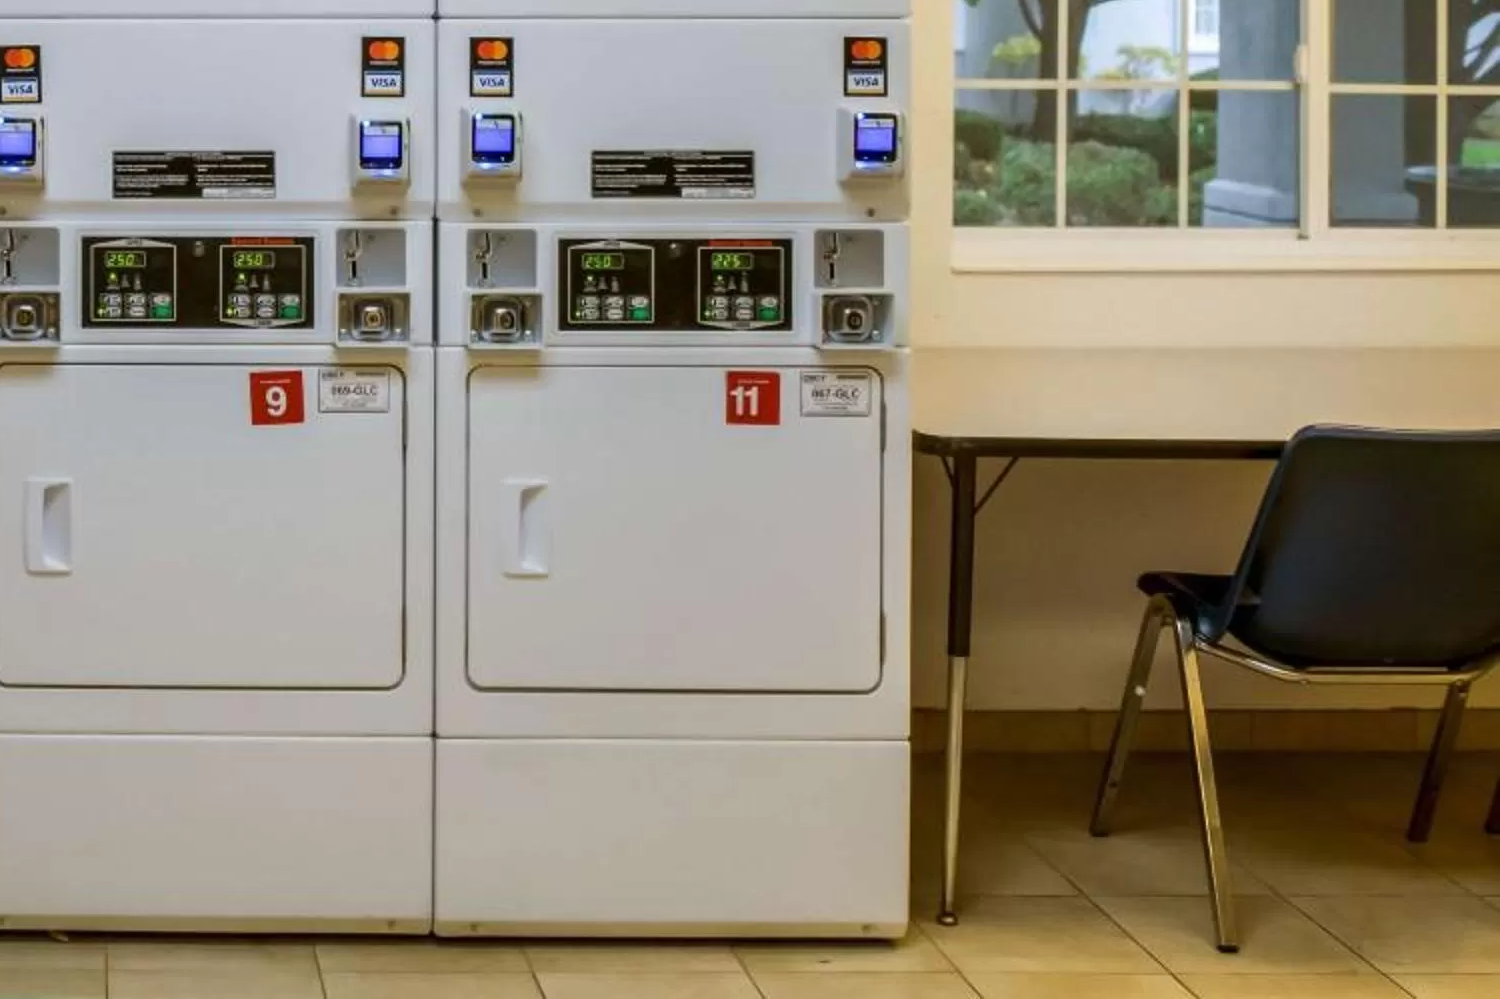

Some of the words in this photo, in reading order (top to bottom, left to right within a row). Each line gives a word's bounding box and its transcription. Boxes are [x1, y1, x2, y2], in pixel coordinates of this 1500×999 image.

[371, 77, 397, 87] VISA
[479, 77, 505, 87] VISA
[853, 77, 879, 87] VISA
[7, 84, 33, 94] VISA
[265, 385, 288, 417] 9
[729, 385, 759, 416] 11
